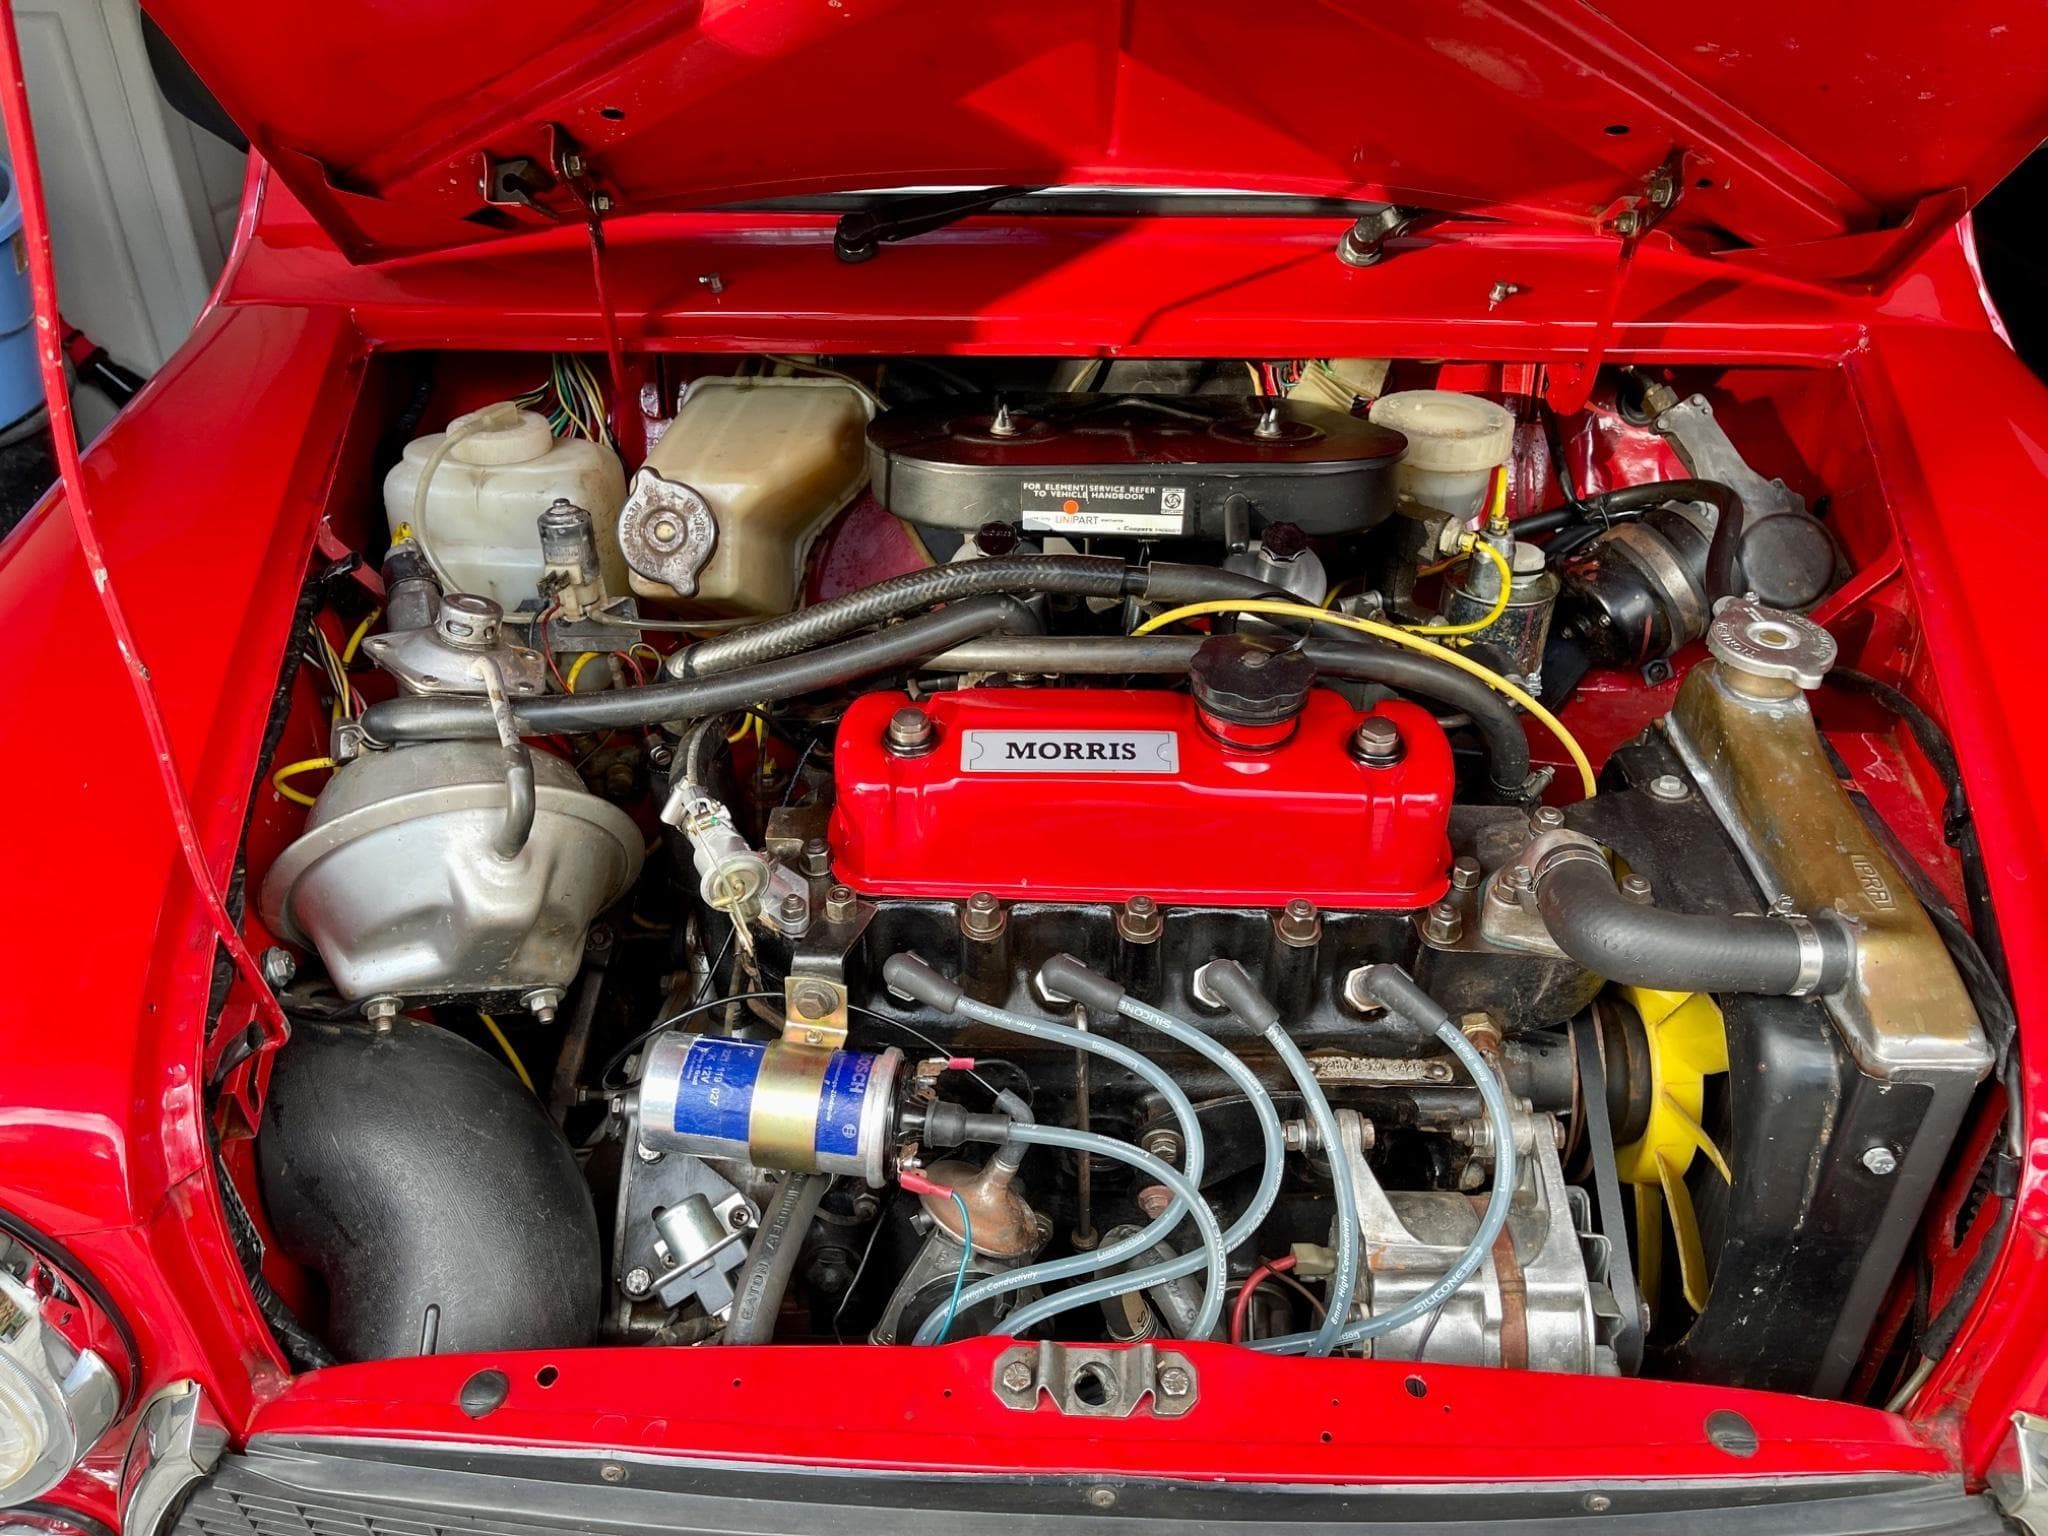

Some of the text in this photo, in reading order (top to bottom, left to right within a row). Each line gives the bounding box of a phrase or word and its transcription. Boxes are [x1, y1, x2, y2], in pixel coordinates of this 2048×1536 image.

[1023, 482, 1041, 491] FOR
[1044, 483, 1085, 492] ELEMENT
[1088, 484, 1125, 494] SERVICE
[1129, 486, 1156, 494] REFER
[1034, 490, 1145, 501] TO VEHICLE HANDBOOK
[1055, 515, 1099, 525] UNIPART
[1006, 742, 1136, 760] MORRIS
[708, 1086, 720, 1106] 027
[1213, 1226, 1227, 1301] SILICONE
[742, 1262, 769, 1321] EATON
[966, 1286, 986, 1302] High
[1338, 1274, 1350, 1298] High
[1414, 1267, 1466, 1314] SILICONE
